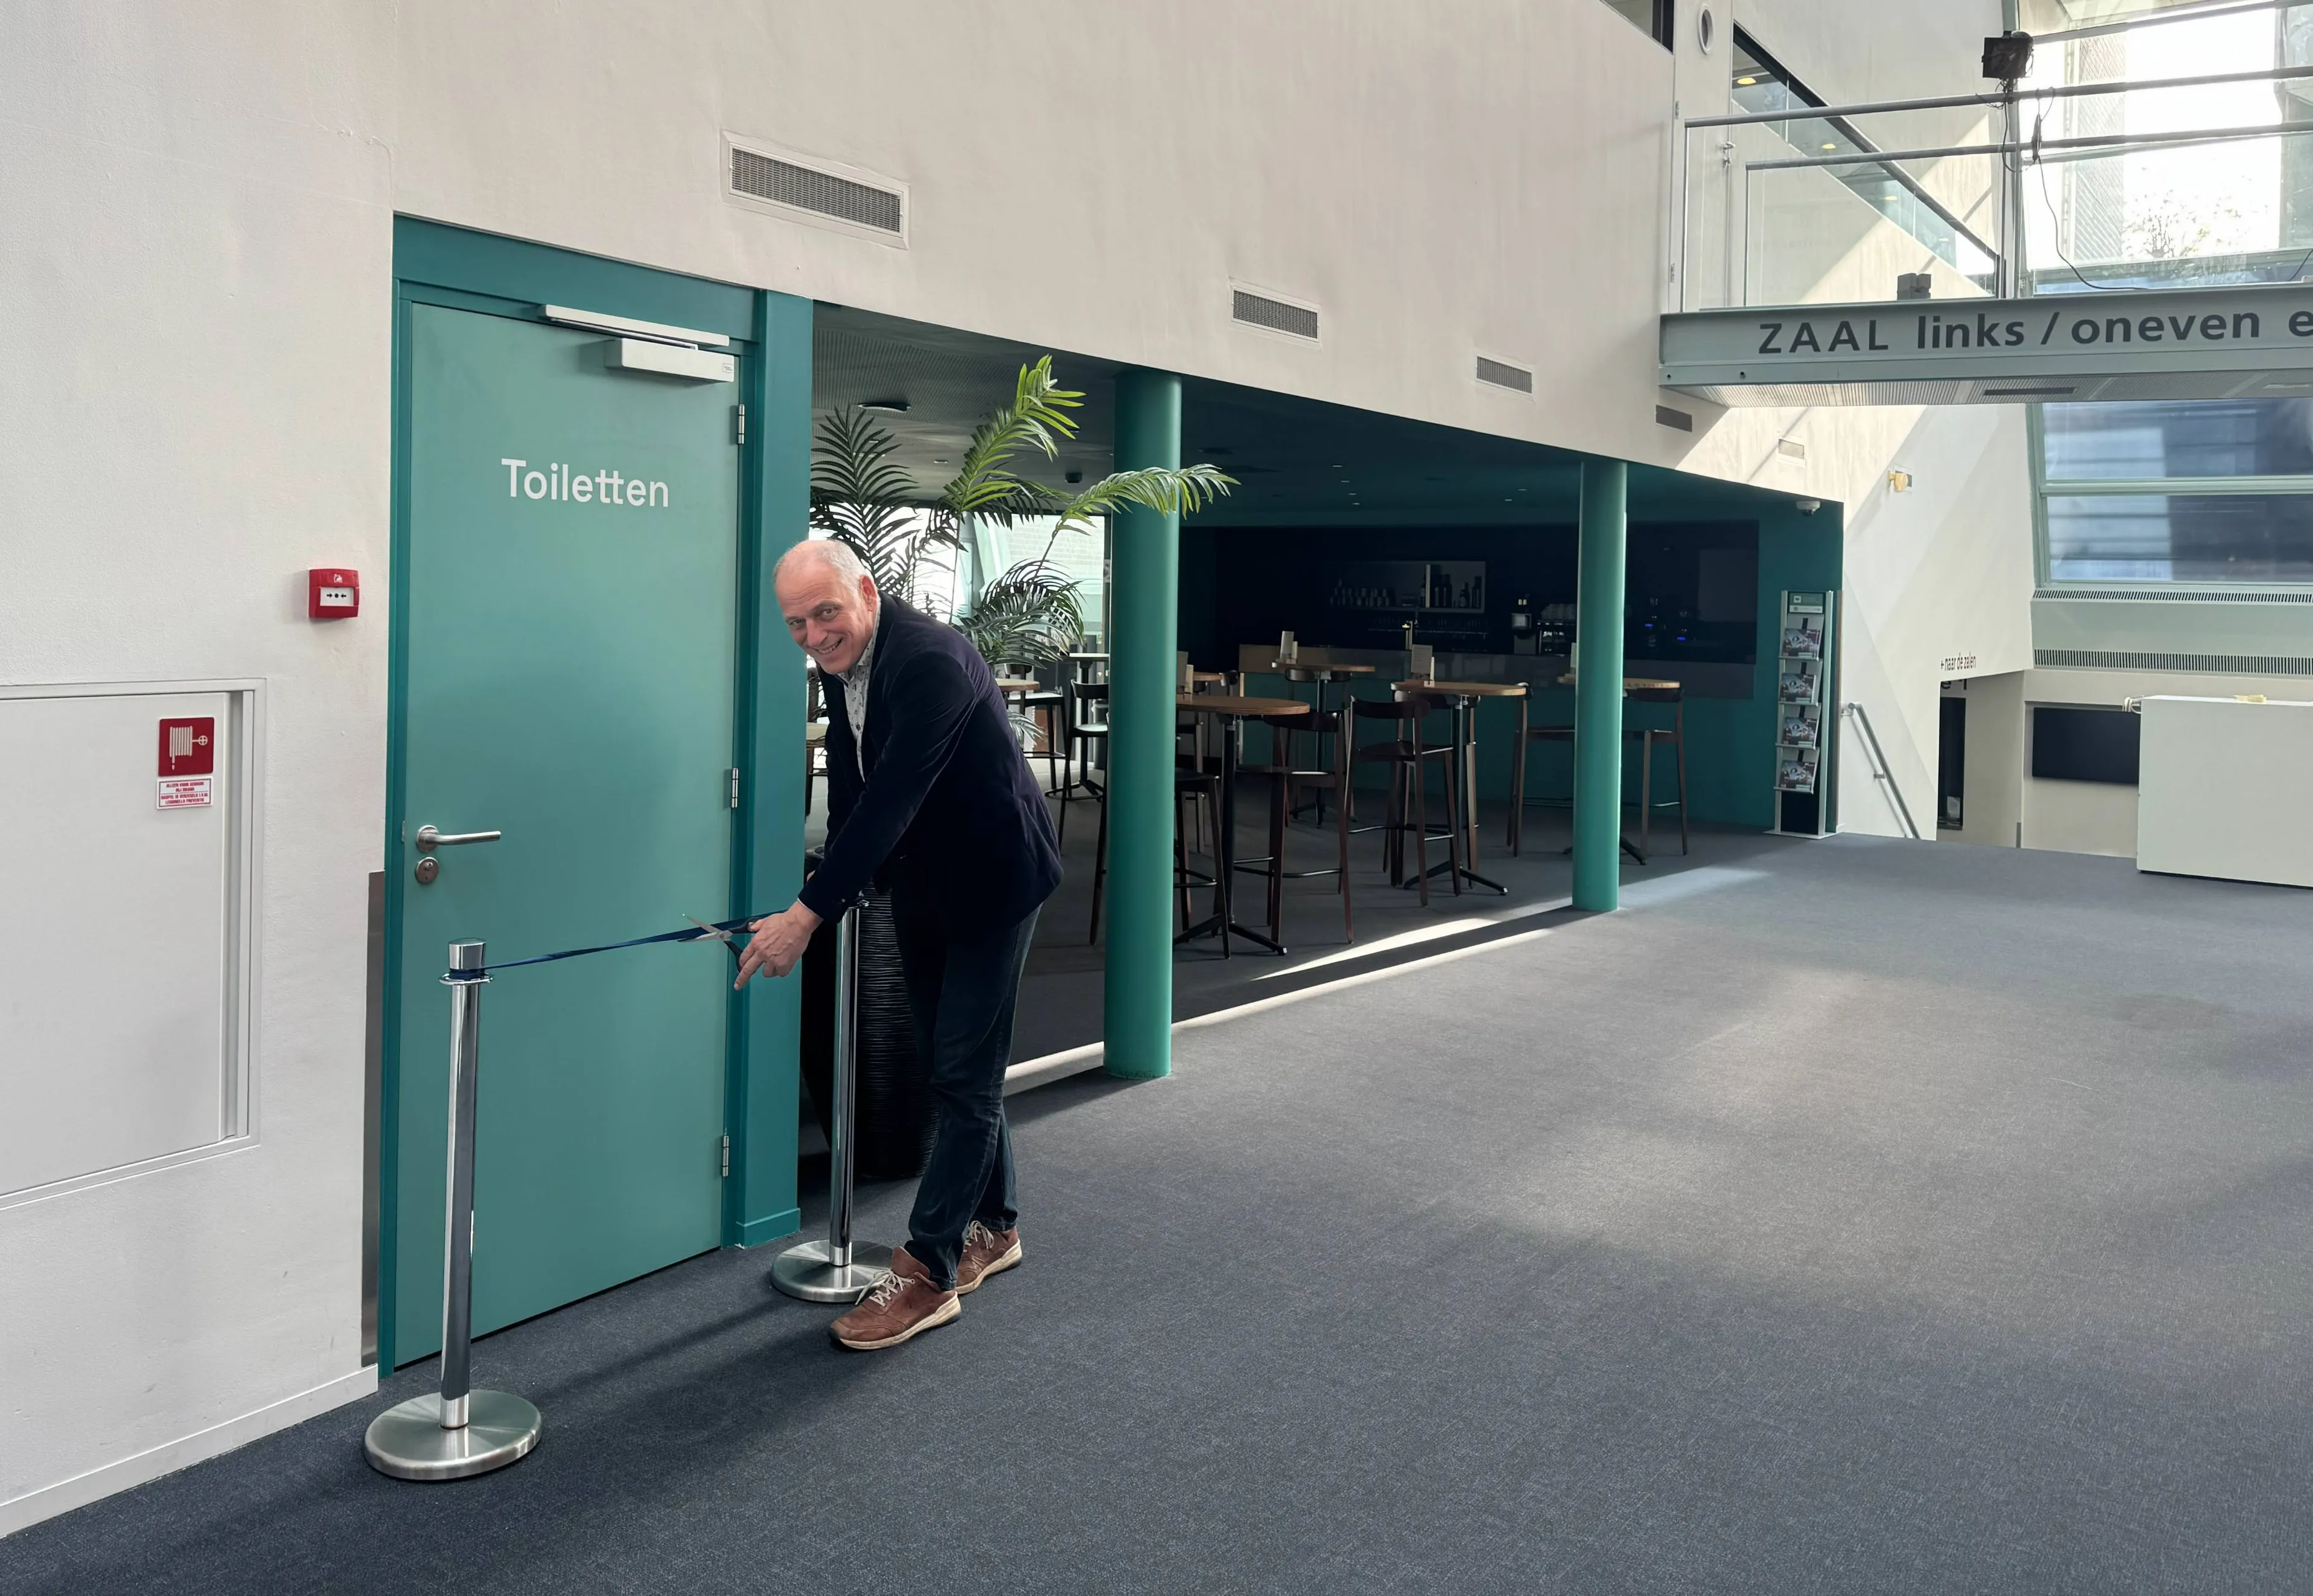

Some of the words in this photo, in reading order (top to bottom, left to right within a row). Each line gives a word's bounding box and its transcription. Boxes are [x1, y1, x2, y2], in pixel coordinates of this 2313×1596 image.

[1758, 319, 1888, 354] ZAAL
[1917, 312, 2024, 349] links
[2071, 310, 2260, 344] oneven
[501, 458, 669, 507] Toiletten
[1945, 658, 1956, 671] naar
[1957, 651, 1963, 670] de
[1964, 651, 1976, 669] zalen
